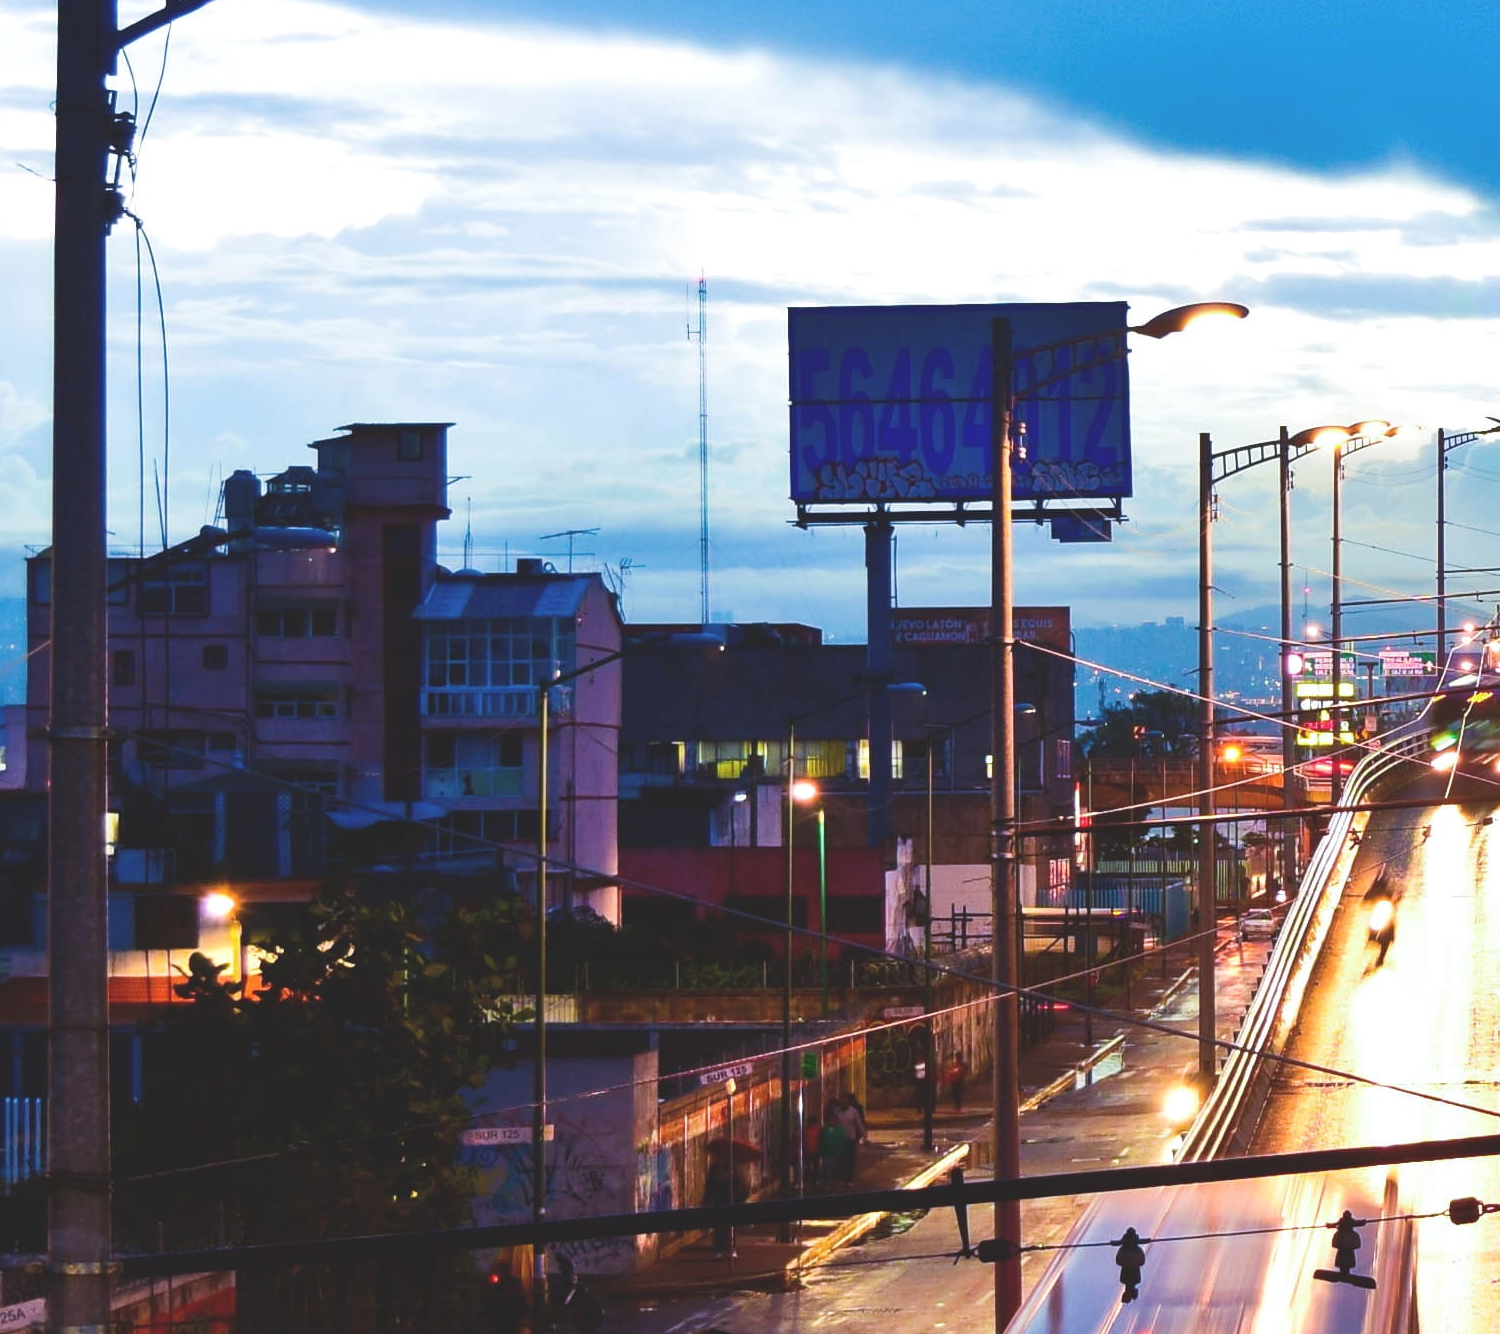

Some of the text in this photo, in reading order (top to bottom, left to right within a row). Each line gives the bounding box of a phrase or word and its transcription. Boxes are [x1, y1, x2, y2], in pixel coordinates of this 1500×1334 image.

[706, 1065, 747, 1083] SUR 125
[474, 1129, 521, 1141] SUR 125
